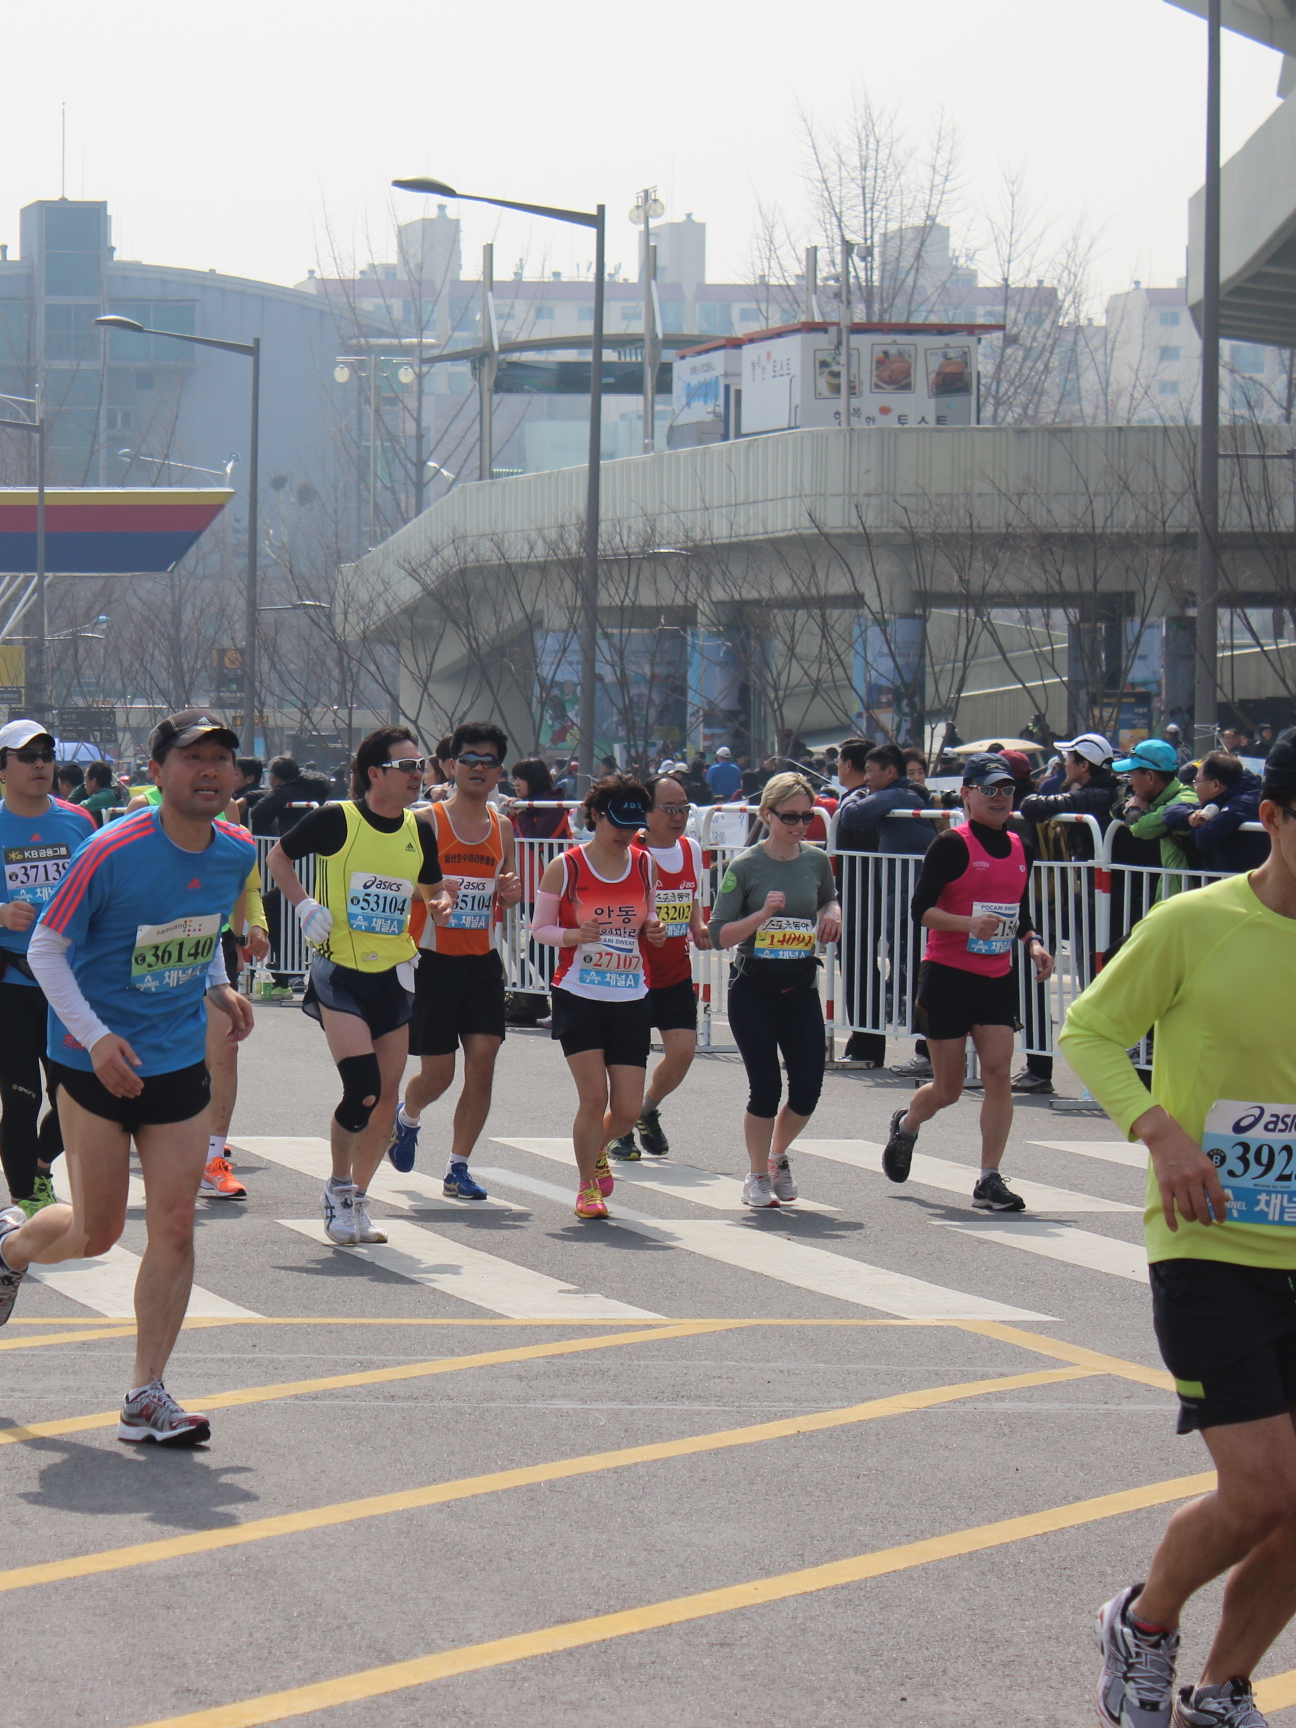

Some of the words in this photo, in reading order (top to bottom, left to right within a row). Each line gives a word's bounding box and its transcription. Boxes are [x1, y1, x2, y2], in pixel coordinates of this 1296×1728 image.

[35, 886, 54, 901] 채
[375, 879, 403, 892] asics
[463, 881, 486, 891] asics
[360, 892, 407, 916] 53104
[460, 914, 486, 928] 채널A
[594, 905, 637, 925] 안동
[156, 922, 188, 936] samyang
[370, 917, 399, 934] 채널A
[767, 932, 814, 947] 14091
[146, 936, 214, 969] 36140
[593, 951, 641, 971] 27107
[604, 972, 635, 987] 채널A
[1263, 1113, 1296, 1133] asi
[1227, 1141, 1296, 1183] 392
